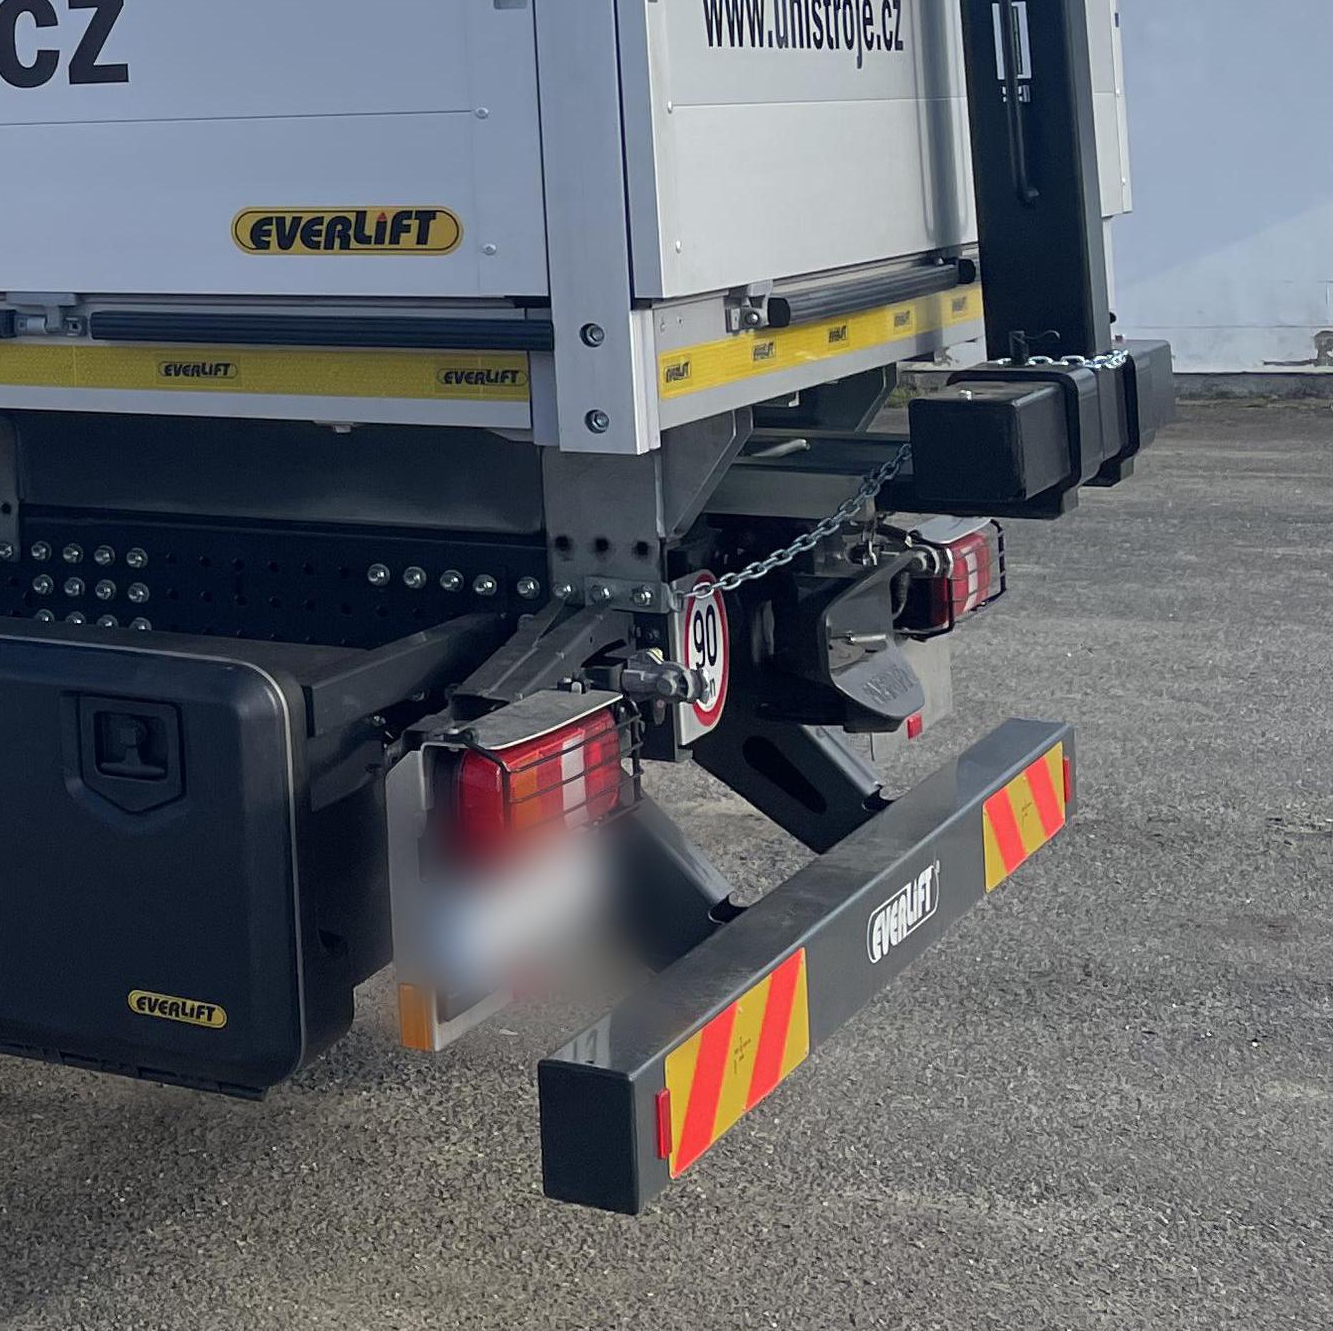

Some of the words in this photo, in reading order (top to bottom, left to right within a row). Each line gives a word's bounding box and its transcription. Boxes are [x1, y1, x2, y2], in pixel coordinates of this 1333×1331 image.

[250, 210, 437, 250] EVERLIFT
[163, 363, 231, 378] EVERLIFT
[443, 370, 520, 385] EVERLIFT
[693, 604, 717, 668] 90
[873, 865, 933, 963] EVERLIFT
[136, 995, 215, 1022] EVERLIFT
